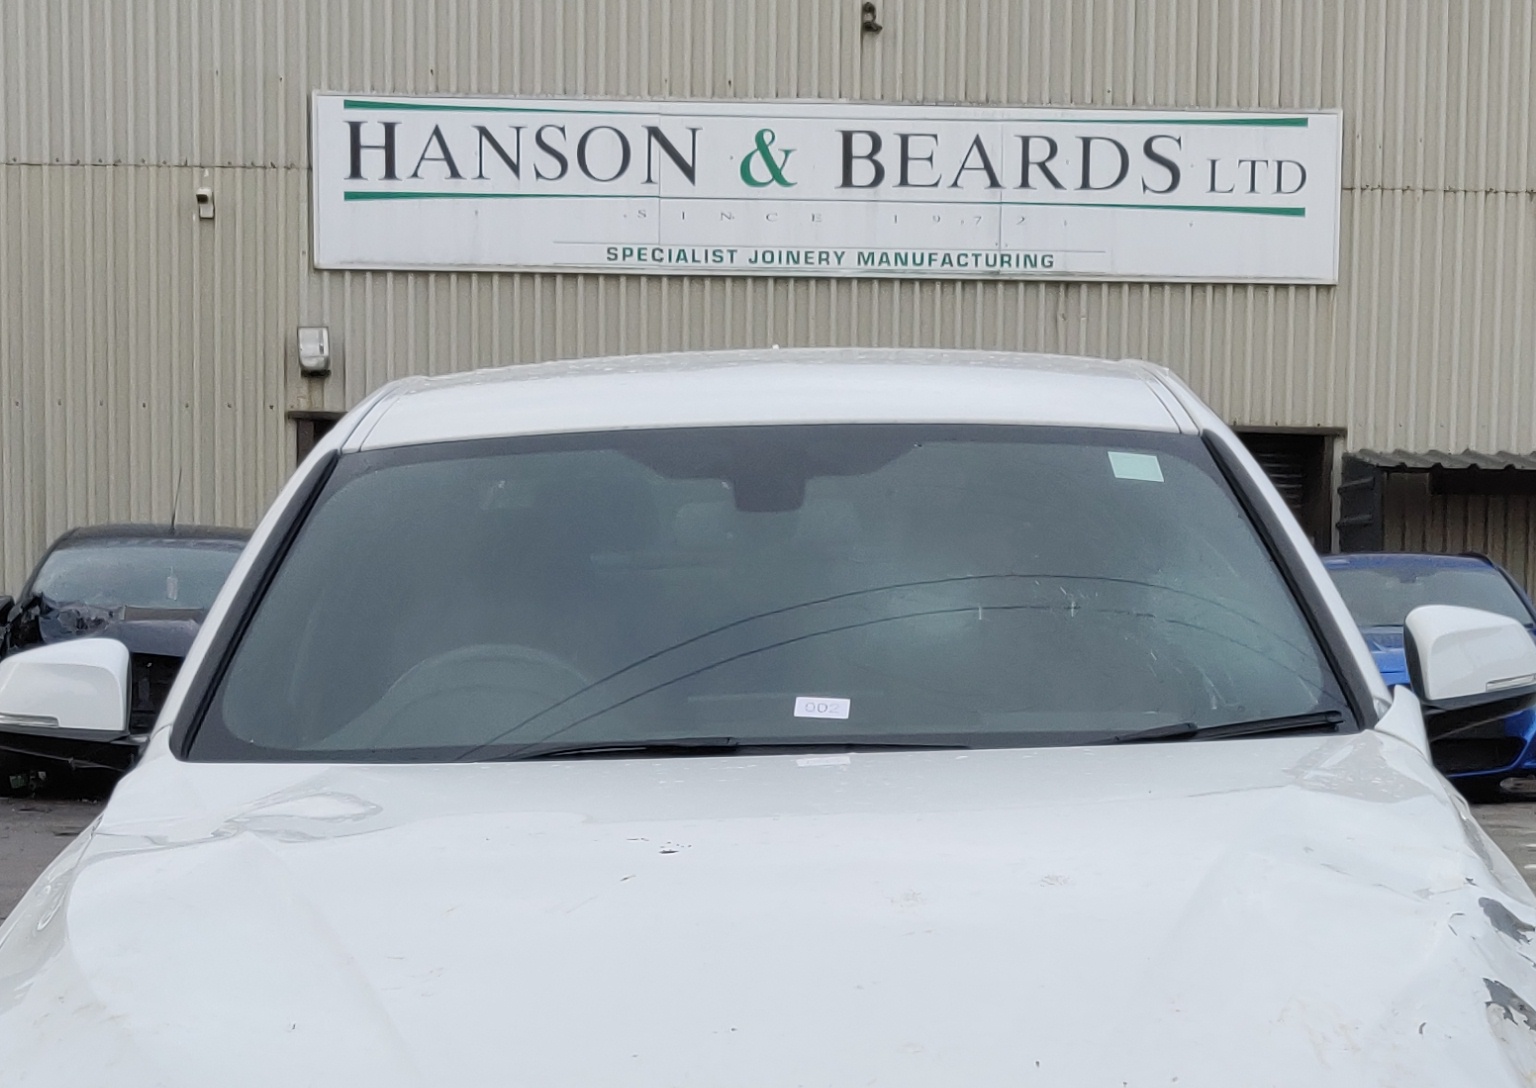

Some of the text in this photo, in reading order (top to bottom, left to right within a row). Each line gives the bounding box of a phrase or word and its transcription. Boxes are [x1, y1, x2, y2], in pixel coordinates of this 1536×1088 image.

[343, 121, 1308, 195] HANSON & BEARDS LTD
[637, 210, 823, 223] SINCE
[606, 247, 1055, 269] SPECIALIST JOINERY MANUFACTURING
